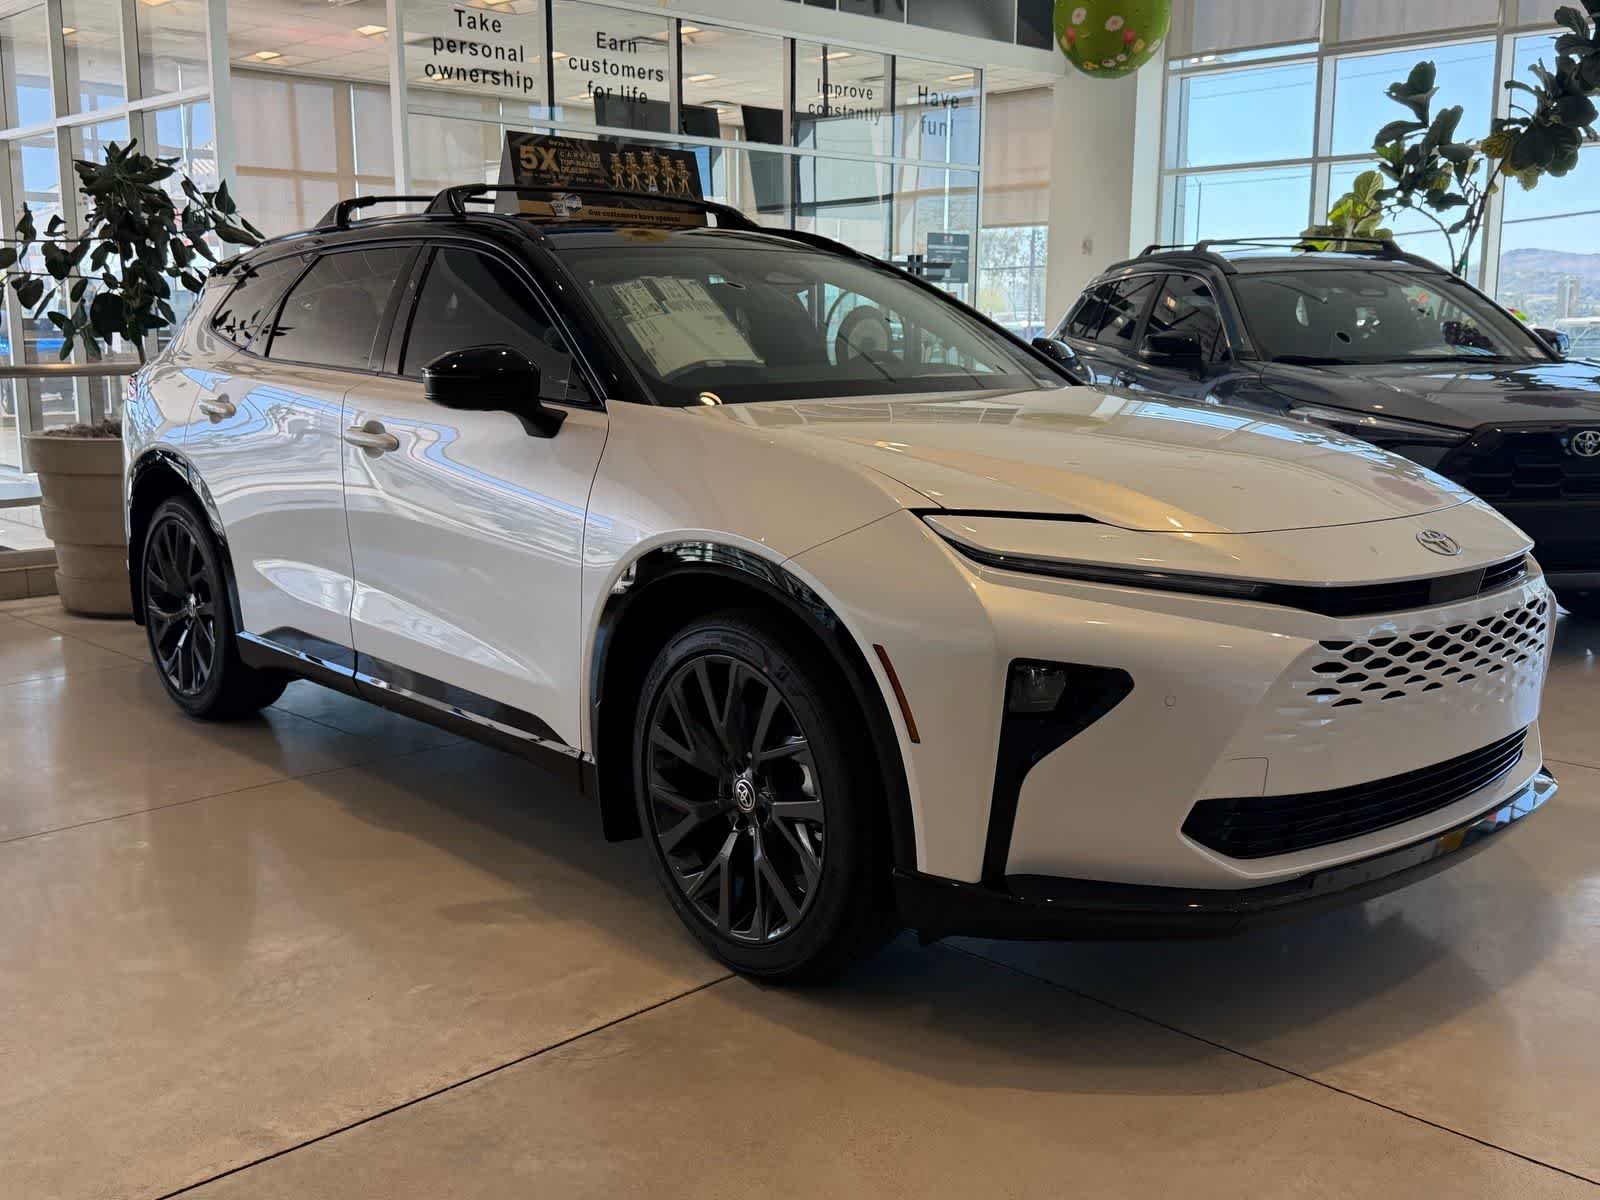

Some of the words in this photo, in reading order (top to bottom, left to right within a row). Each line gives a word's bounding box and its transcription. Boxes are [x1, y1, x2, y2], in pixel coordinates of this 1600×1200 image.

[453, 9, 502, 33] Take
[433, 37, 524, 63] personal
[596, 32, 637, 54] Earn
[425, 63, 534, 93] ownership
[568, 57, 664, 82] customers
[587, 80, 613, 99] for
[620, 83, 648, 104] life
[817, 78, 873, 100] Improve
[918, 85, 960, 109] Have
[808, 103, 881, 126] constantly
[519, 144, 560, 173] 5X
